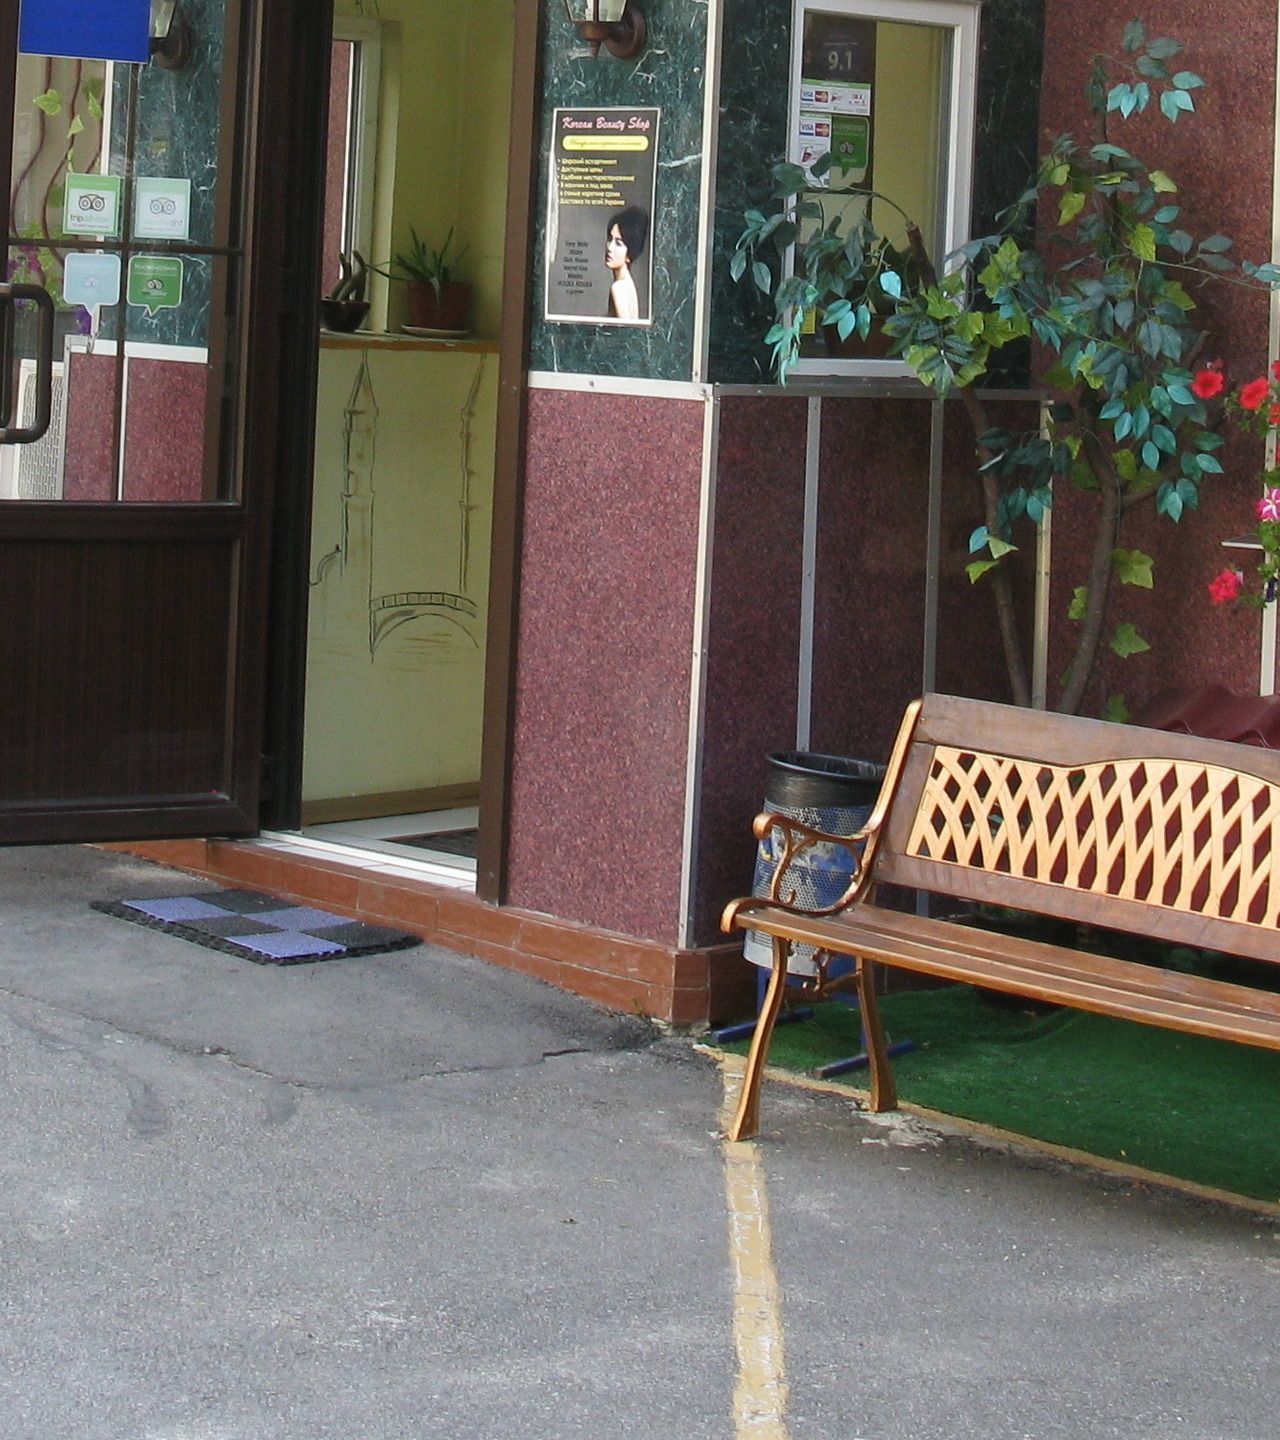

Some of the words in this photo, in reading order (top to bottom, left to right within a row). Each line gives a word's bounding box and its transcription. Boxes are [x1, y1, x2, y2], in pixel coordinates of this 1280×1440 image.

[562, 116, 593, 129] Korean
[596, 116, 626, 131] Beauty
[628, 116, 650, 131] Shop
